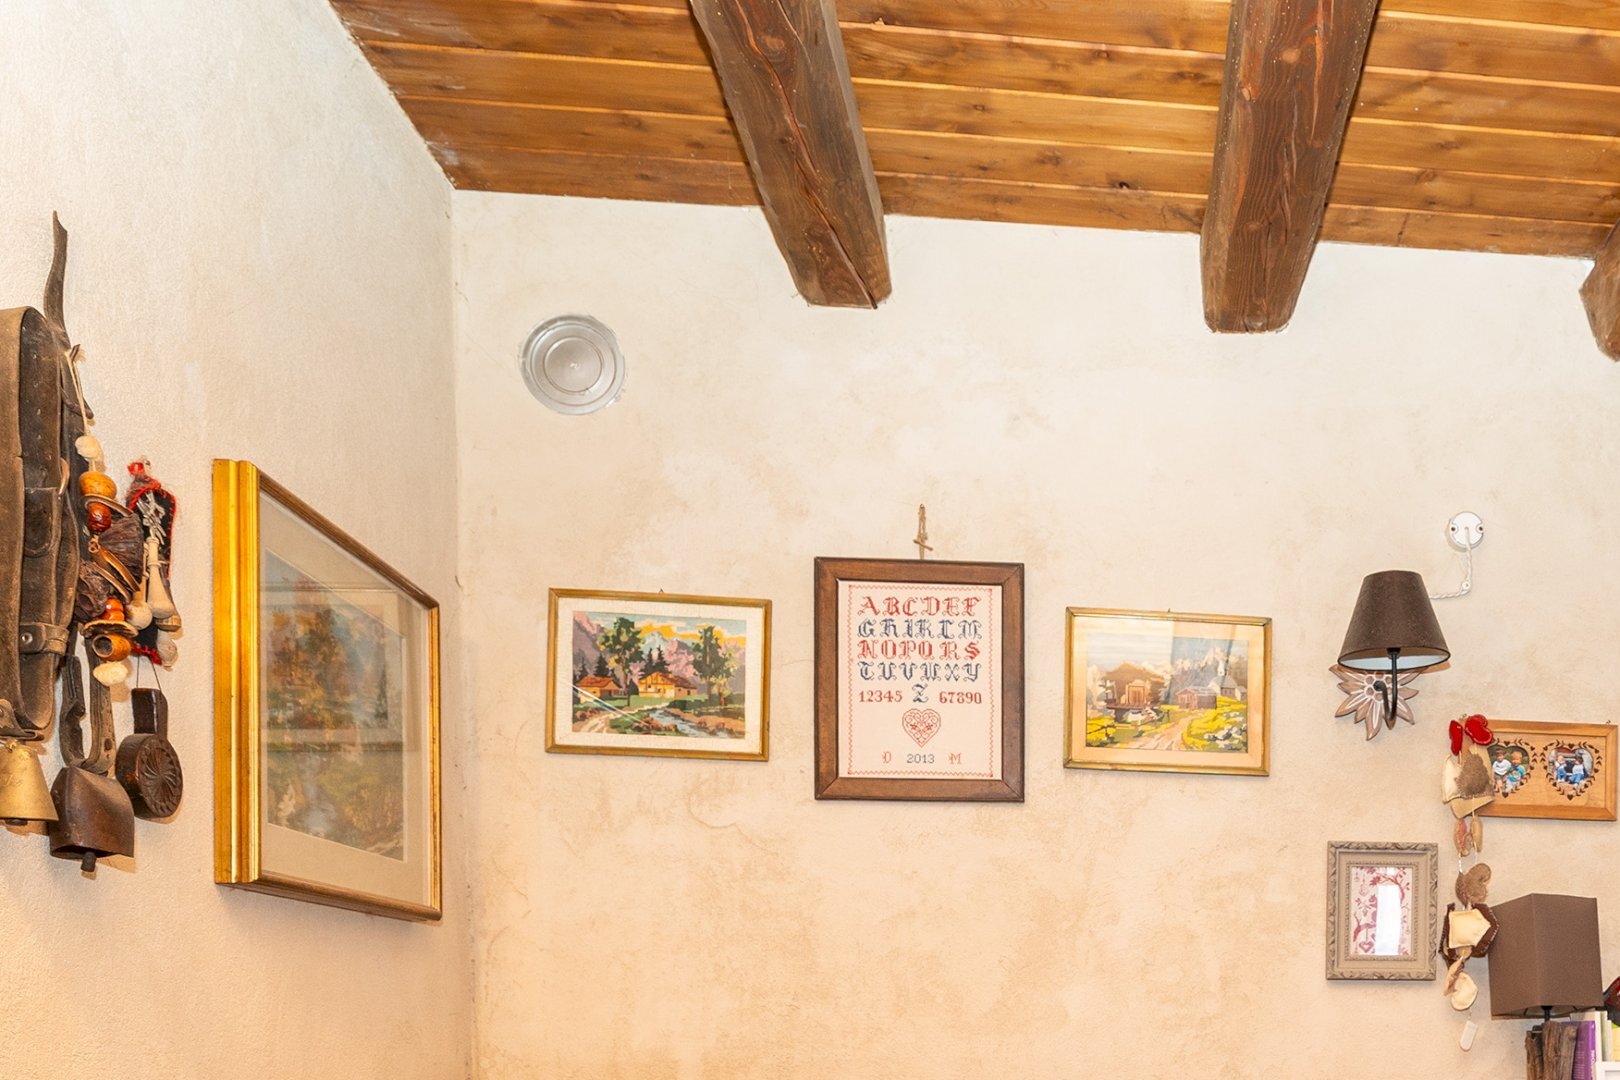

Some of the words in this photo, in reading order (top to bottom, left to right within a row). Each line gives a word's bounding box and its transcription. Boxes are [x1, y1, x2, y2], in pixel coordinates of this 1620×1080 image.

[859, 690, 903, 703] 12345
[939, 691, 982, 704] 67890
[906, 753, 936, 764] 2013
